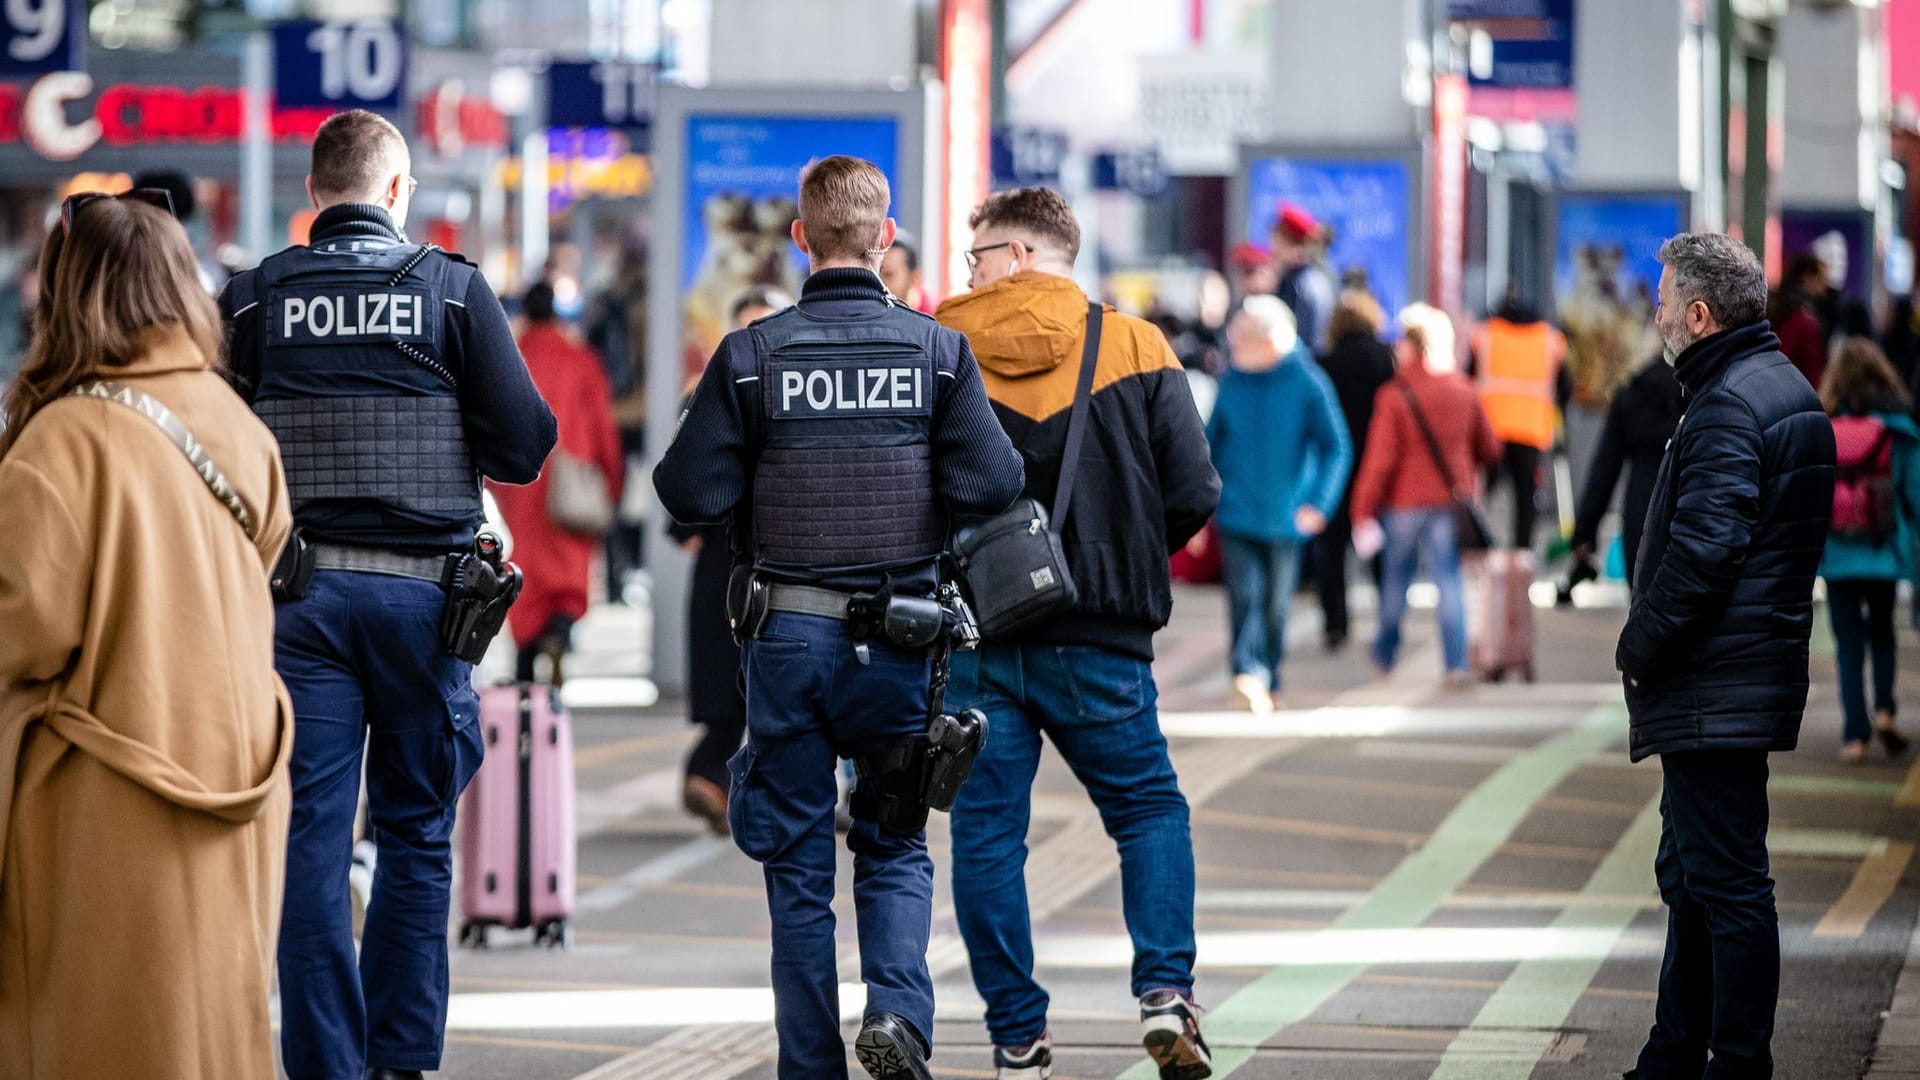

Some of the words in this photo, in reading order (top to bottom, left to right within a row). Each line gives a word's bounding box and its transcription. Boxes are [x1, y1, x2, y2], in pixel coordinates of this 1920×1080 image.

[4, 0, 66, 62] 9
[306, 20, 401, 100] 10
[283, 293, 422, 338] POLIZEI
[782, 368, 922, 411] POLIZEI
